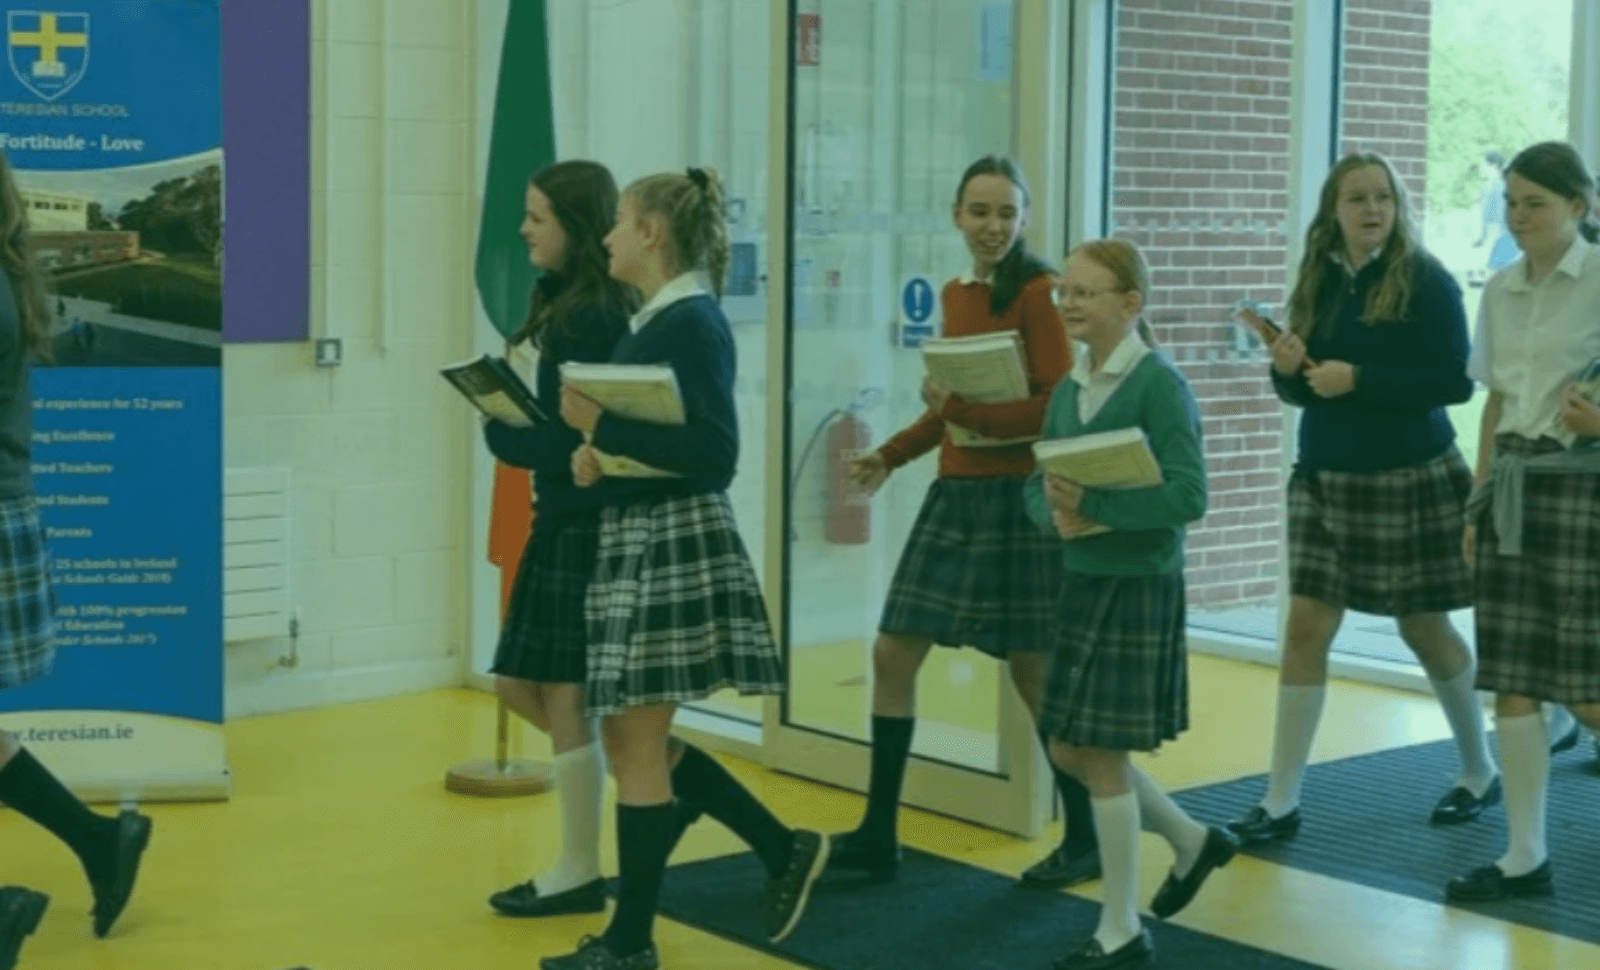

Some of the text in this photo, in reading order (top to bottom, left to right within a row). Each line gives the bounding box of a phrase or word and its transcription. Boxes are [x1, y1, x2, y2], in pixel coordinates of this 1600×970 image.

[72, 104, 129, 117] SCHOOL
[0, 133, 86, 150] Fortitude
[101, 134, 145, 151] Love
[112, 397, 130, 409] for
[133, 397, 148, 409] 52
[150, 399, 184, 411] years
[52, 430, 114, 442] Excellence
[59, 463, 113, 473] Teachers
[46, 527, 93, 538] Parents
[73, 558, 117, 569] schools
[134, 557, 177, 569] Ireland
